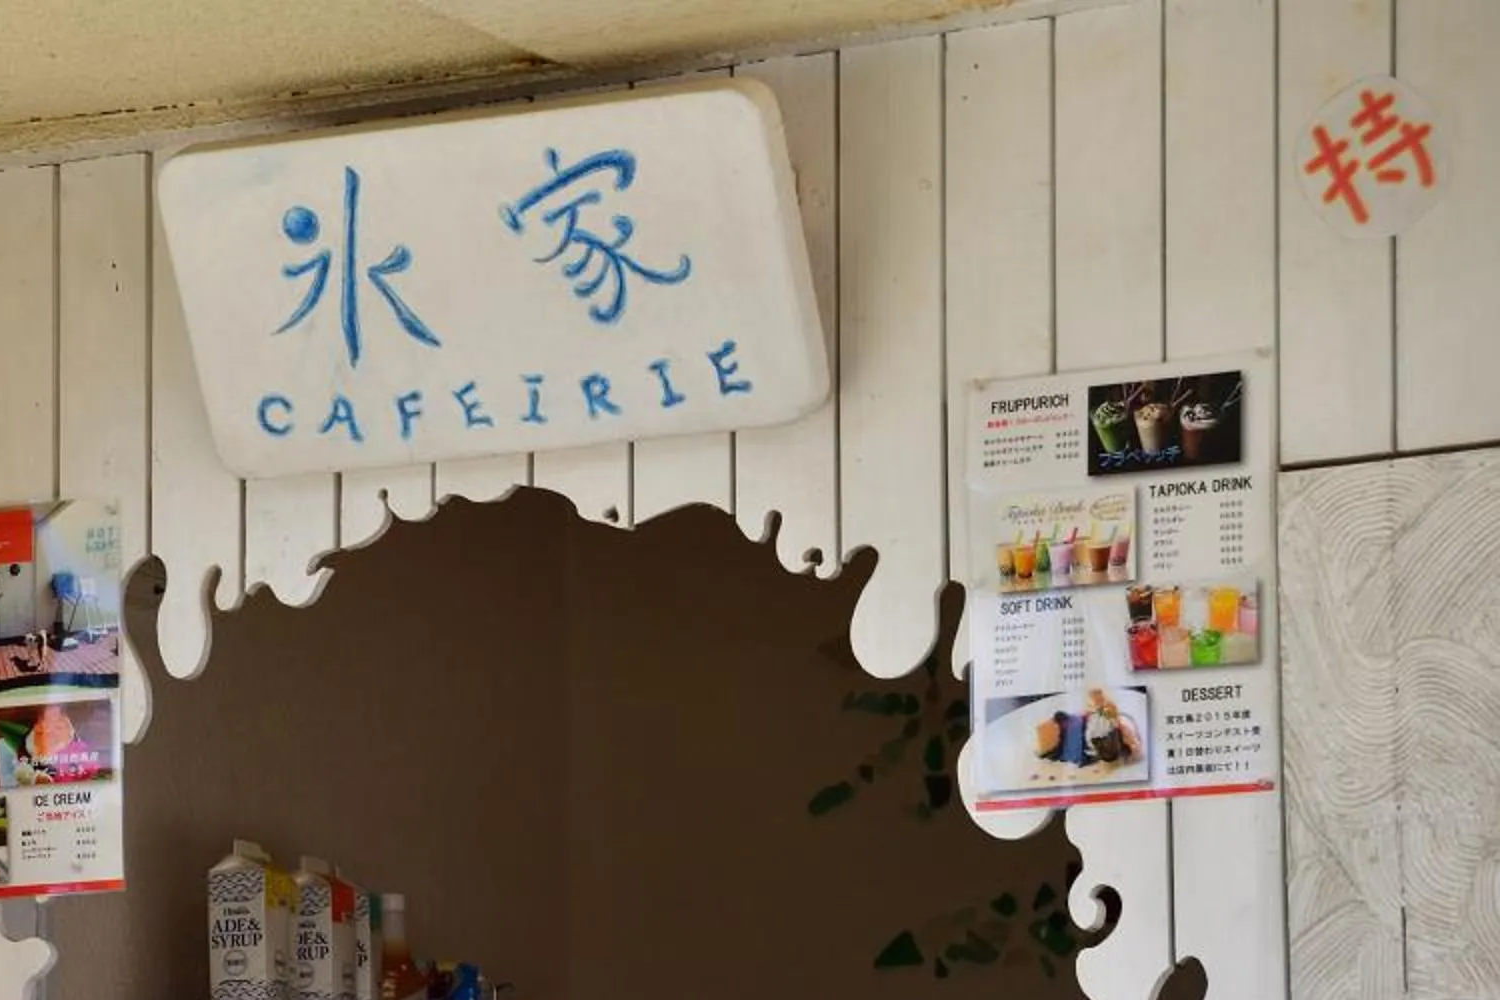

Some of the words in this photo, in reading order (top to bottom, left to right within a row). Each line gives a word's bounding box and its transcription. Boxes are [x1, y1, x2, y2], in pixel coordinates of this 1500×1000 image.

[1303, 88, 1436, 225] 持
[269, 147, 692, 370] 氷家
[256, 340, 754, 443] CAFEIRIE
[1148, 481, 1207, 499] TAPIOKA
[1211, 475, 1253, 494] DRINK
[1000, 598, 1031, 616] SOFT
[1035, 595, 1073, 613] DRINK
[1181, 684, 1244, 703] DESSERT
[34, 794, 49, 808] ICE
[53, 791, 91, 806] CREAM
[211, 933, 263, 949] SYRUP
[296, 945, 330, 961] RUP
